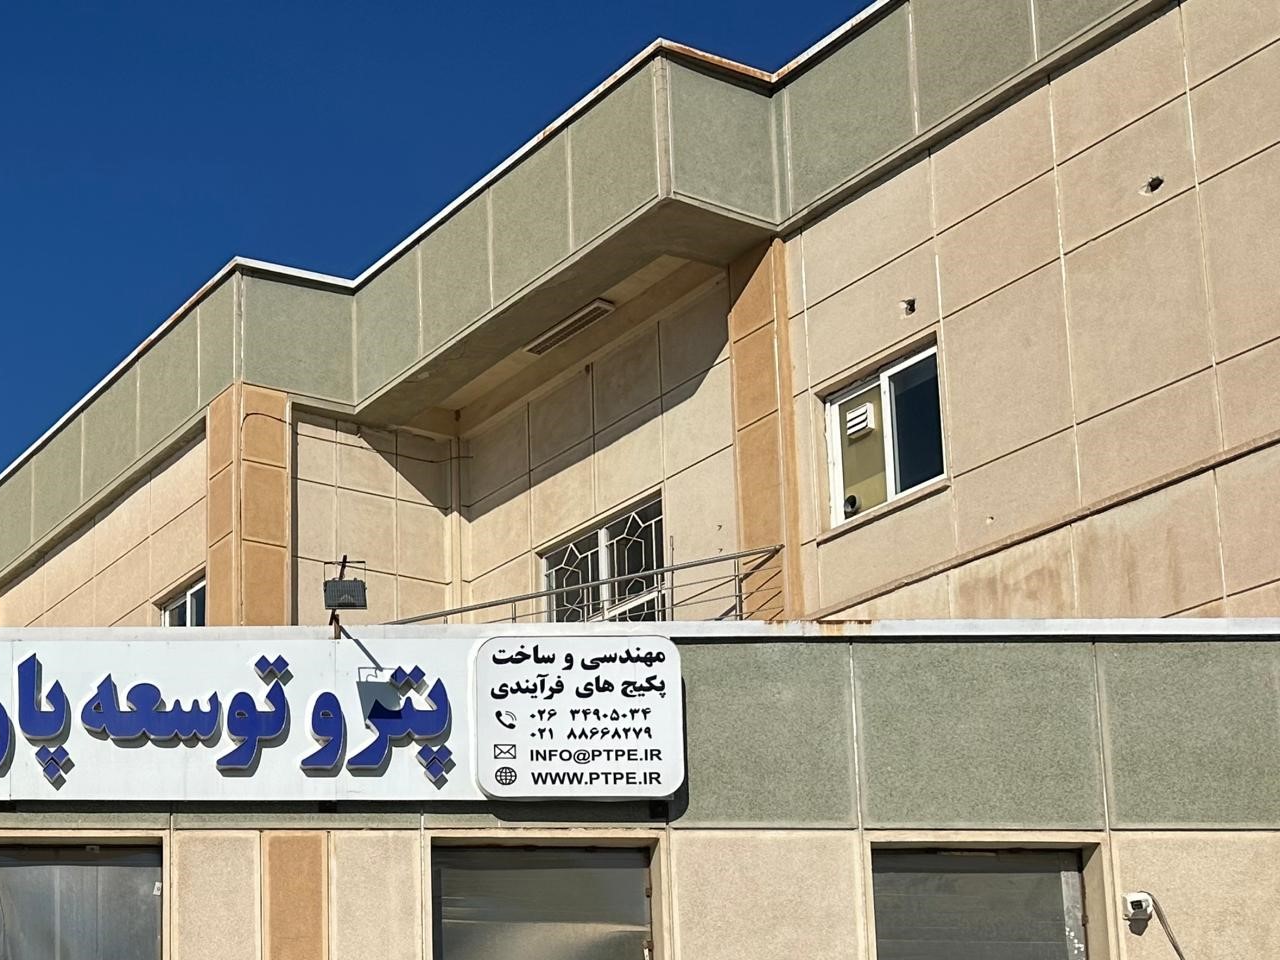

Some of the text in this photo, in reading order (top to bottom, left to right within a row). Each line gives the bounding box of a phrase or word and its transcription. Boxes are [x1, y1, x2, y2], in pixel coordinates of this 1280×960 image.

[492, 644, 666, 670] مهندسی و ساخت
[490, 673, 666, 699] پکیج های فرآیندی
[81, 654, 289, 768] توسعه
[300, 665, 452, 783] پترو
[530, 749, 663, 764] INFO@PTPE.IR
[531, 772, 662, 785] WWW.PTPE.IR
